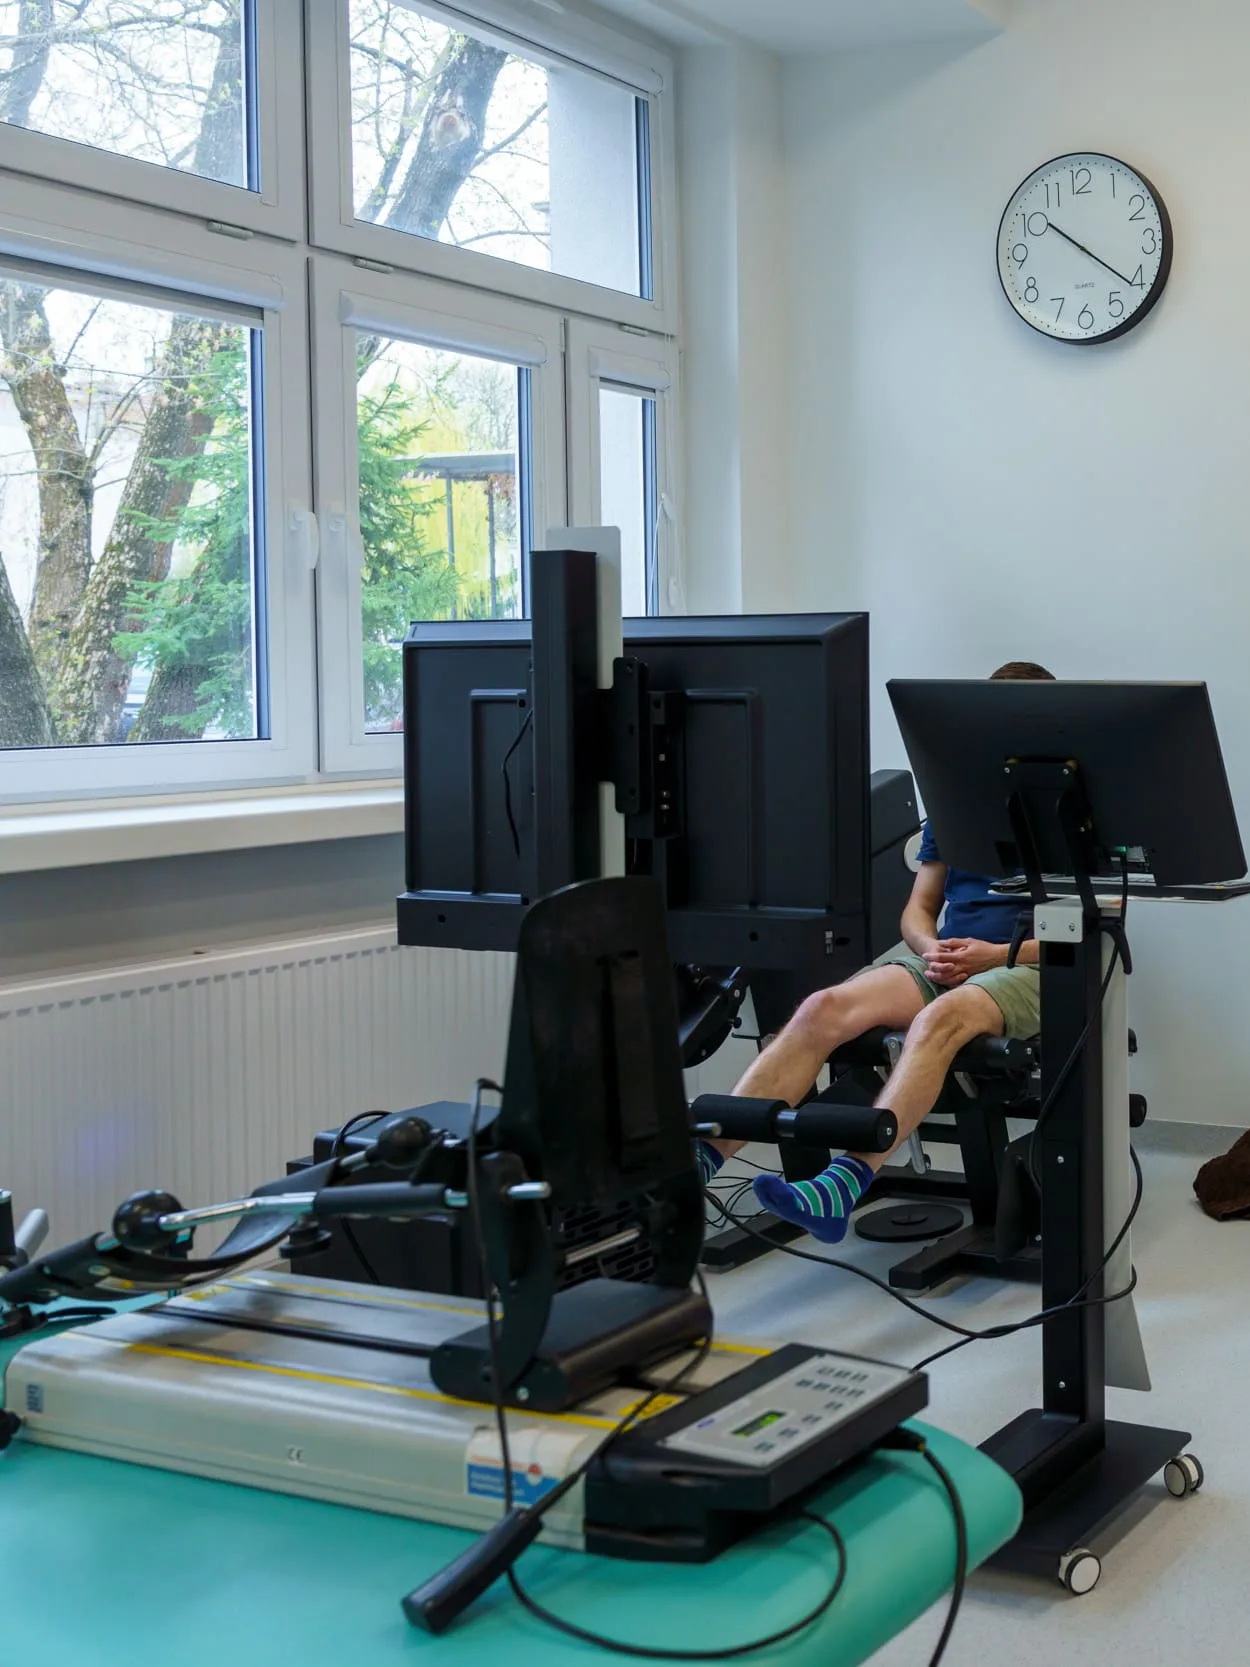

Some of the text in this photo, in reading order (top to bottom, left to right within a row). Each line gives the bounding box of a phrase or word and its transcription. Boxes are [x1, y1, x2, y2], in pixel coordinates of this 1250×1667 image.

[1044, 182, 1061, 209] 11
[1069, 168, 1092, 196] 12
[1109, 172, 1116, 199] 1
[1128, 194, 1146, 221] 2
[1021, 211, 1049, 238] 10
[1141, 228, 1157, 255] 3
[1011, 243, 1029, 270] 9
[1024, 276, 1039, 303] 8
[1130, 263, 1146, 290] 4
[1050, 297, 1065, 323] 7
[1077, 303, 1095, 330] 6
[1108, 291, 1124, 318] 5
